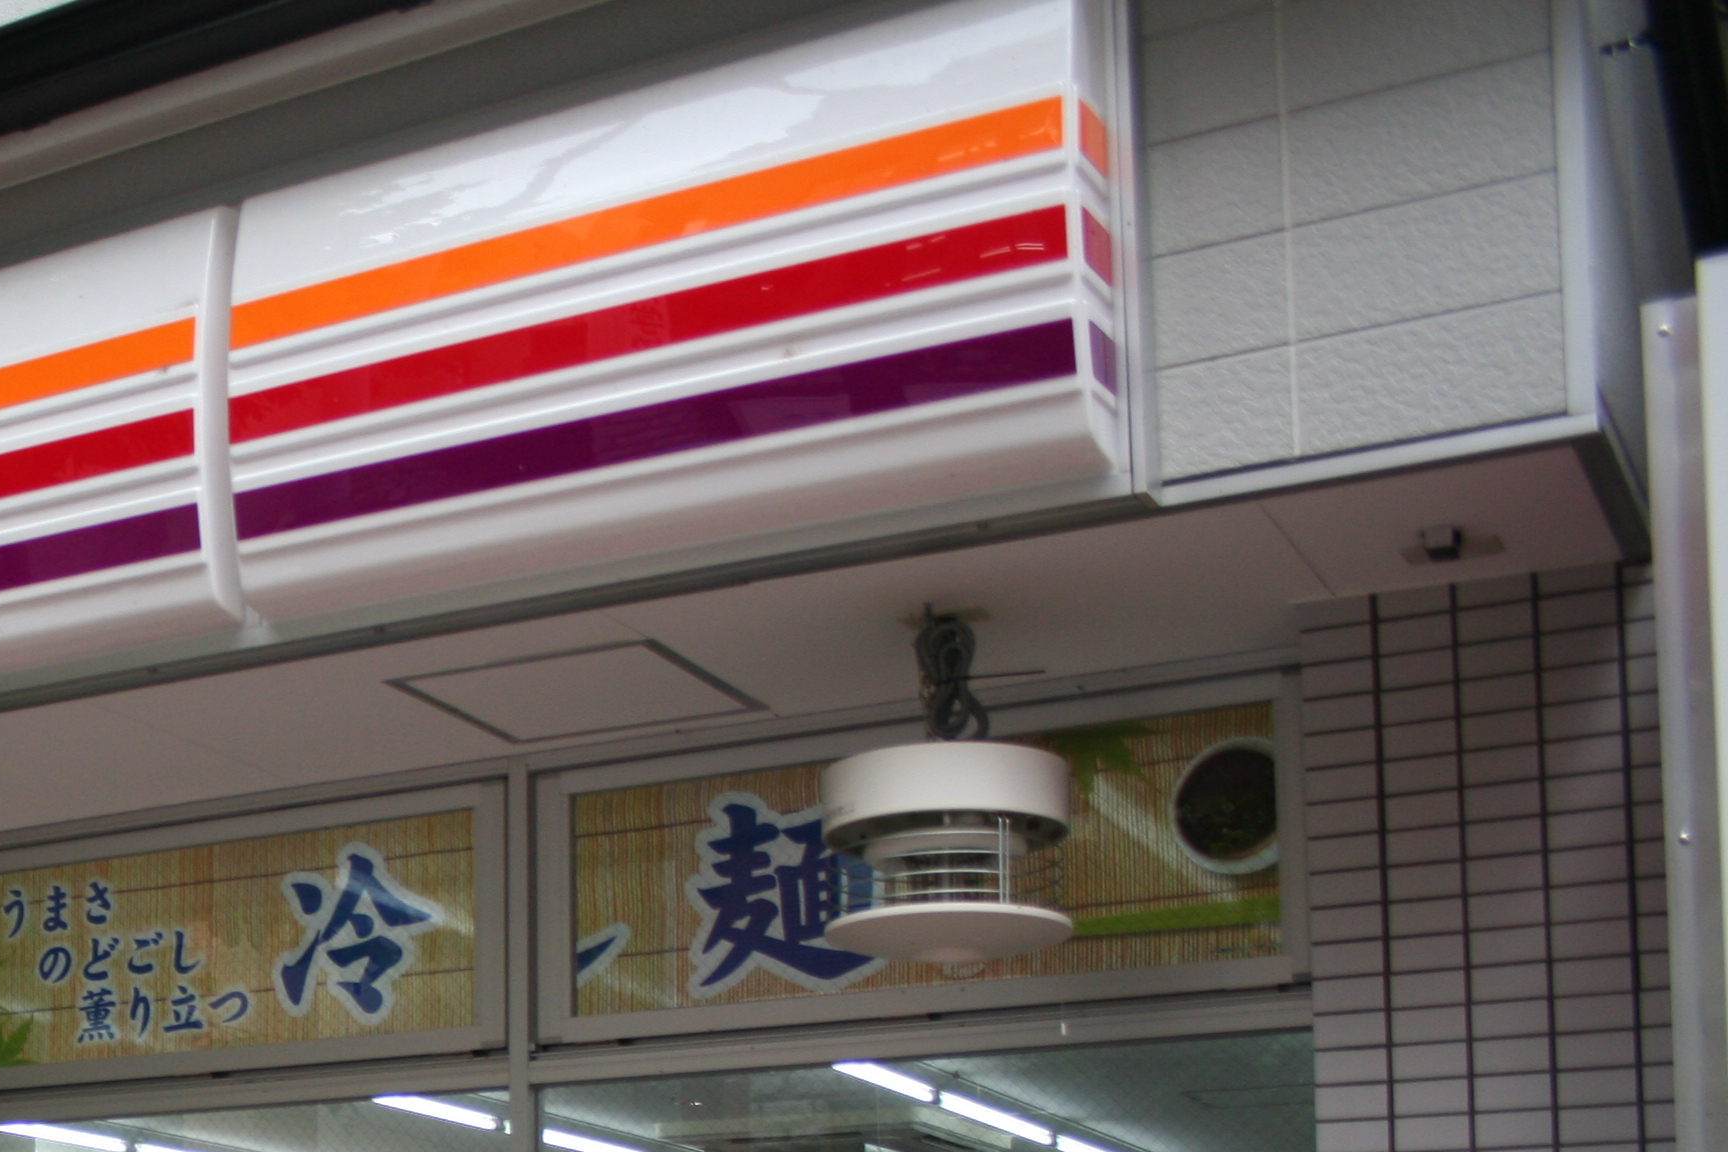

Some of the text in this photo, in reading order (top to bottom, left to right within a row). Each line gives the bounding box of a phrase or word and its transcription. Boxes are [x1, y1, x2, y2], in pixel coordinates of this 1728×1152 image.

[2, 881, 112, 938] うまさ
[281, 852, 432, 1014] 冷
[39, 930, 202, 984] のどごし
[76, 984, 251, 1044] 薫り立つ
